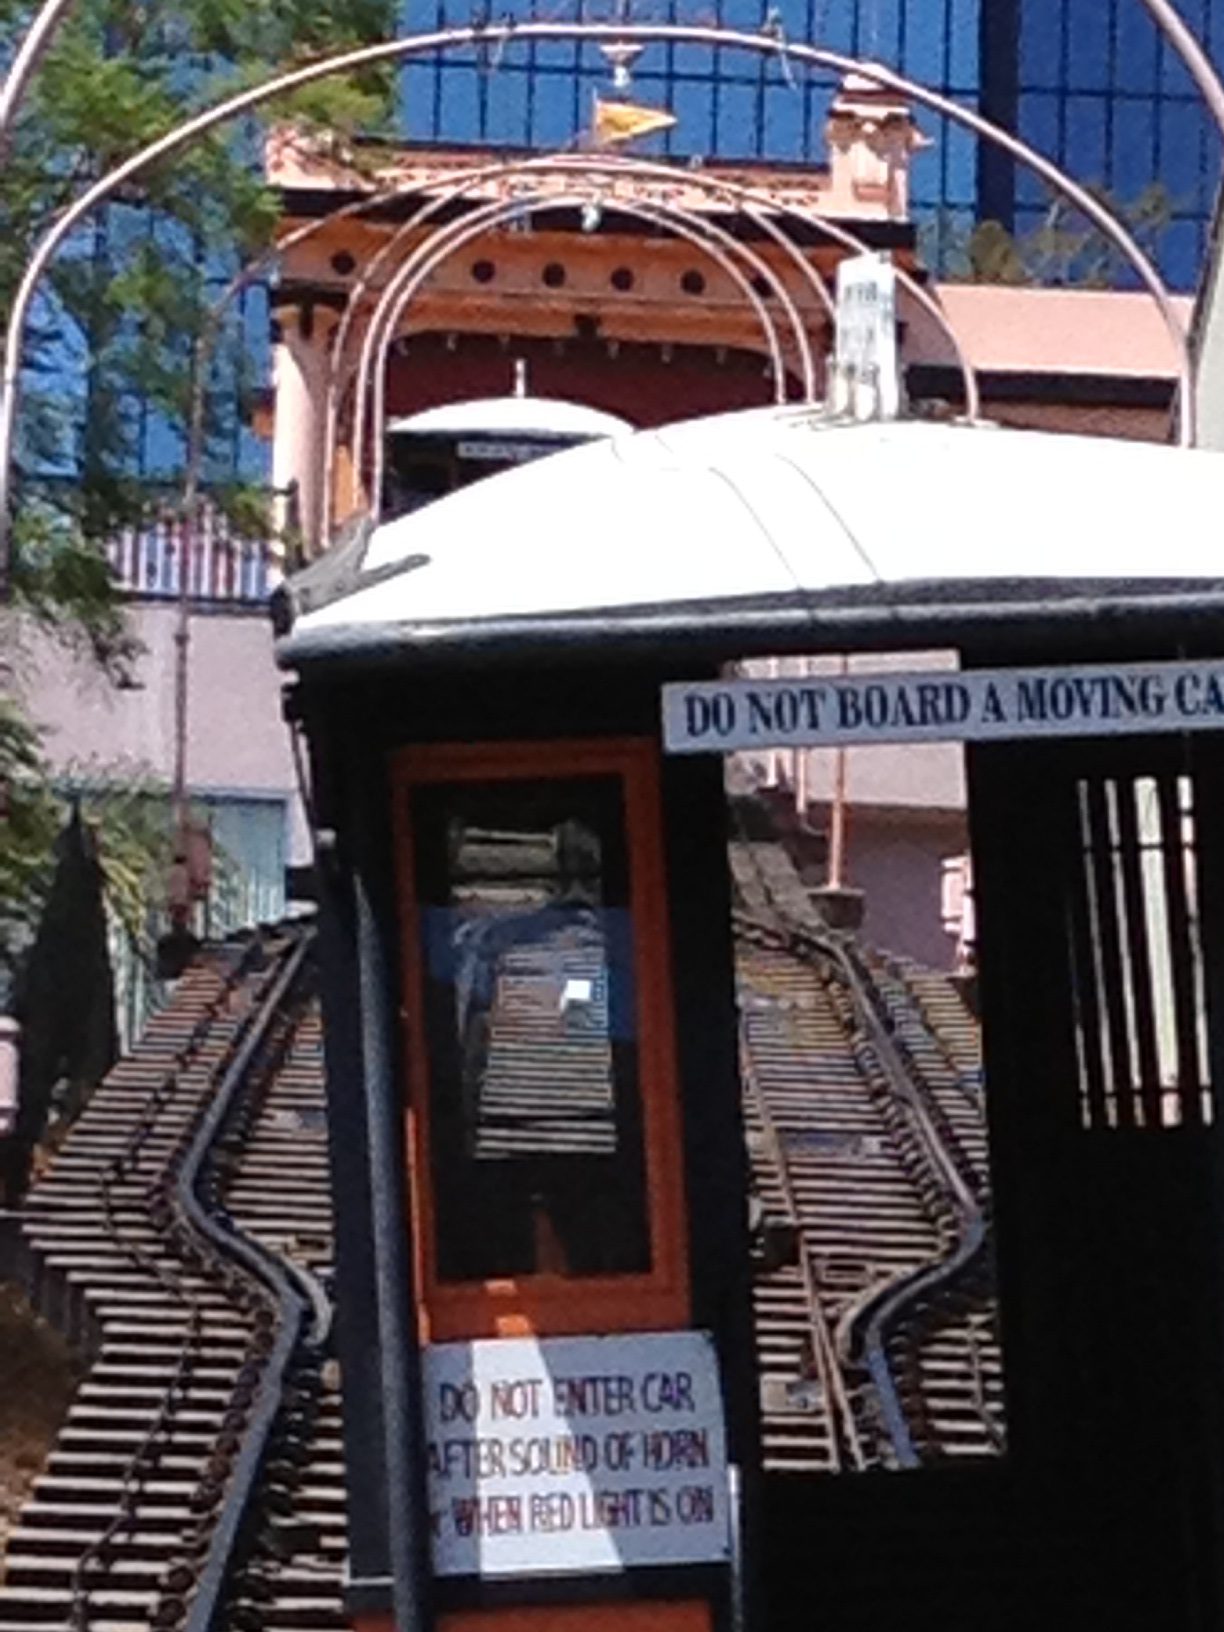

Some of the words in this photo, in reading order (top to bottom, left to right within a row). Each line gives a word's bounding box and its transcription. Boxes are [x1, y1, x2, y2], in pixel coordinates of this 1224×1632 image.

[685, 693, 736, 736] DO
[748, 687, 827, 733] NOT
[832, 681, 970, 729] BOARD
[981, 682, 1006, 723] A
[1016, 675, 1166, 723] MOVING
[440, 1382, 480, 1423] DO
[491, 1379, 542, 1420] NOT
[553, 1375, 637, 1418] ENTER
[641, 1371, 696, 1413] CAR
[508, 1433, 598, 1477] SOUND
[603, 1431, 634, 1472] OF
[644, 1428, 709, 1472] HORN
[452, 1496, 522, 1537] WHEN
[530, 1492, 577, 1532] RED
[581, 1489, 643, 1530] LIGHT
[648, 1488, 670, 1527] IS
[676, 1485, 714, 1525] ON
